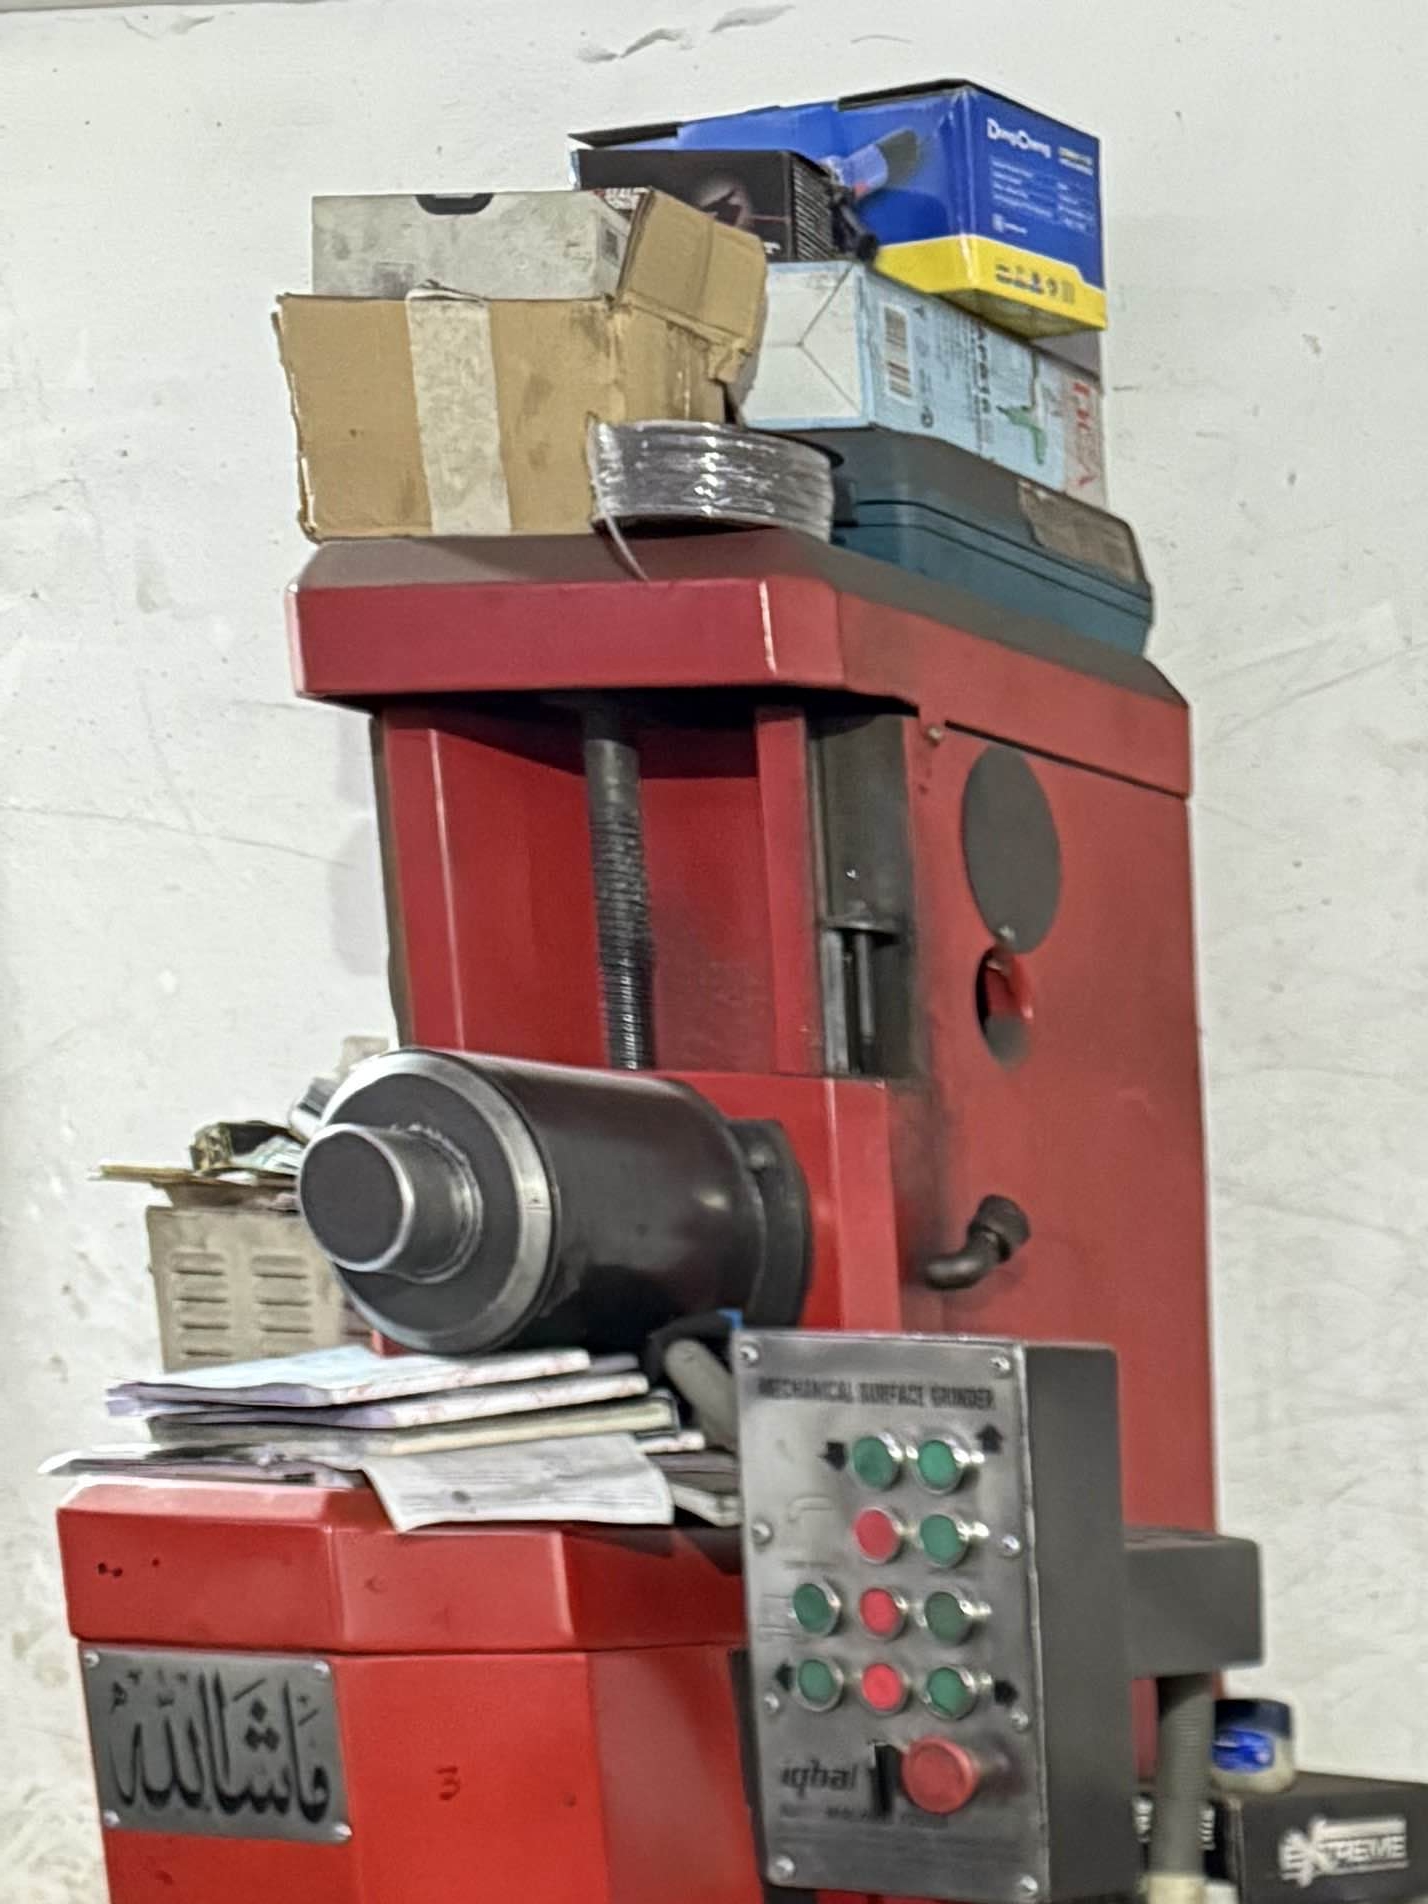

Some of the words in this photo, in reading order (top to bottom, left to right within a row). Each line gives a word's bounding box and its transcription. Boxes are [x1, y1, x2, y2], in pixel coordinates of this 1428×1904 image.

[757, 1377, 853, 1404] MECHANICAL
[858, 1381, 924, 1407] SURFACE
[930, 1385, 996, 1411] GRINDER
